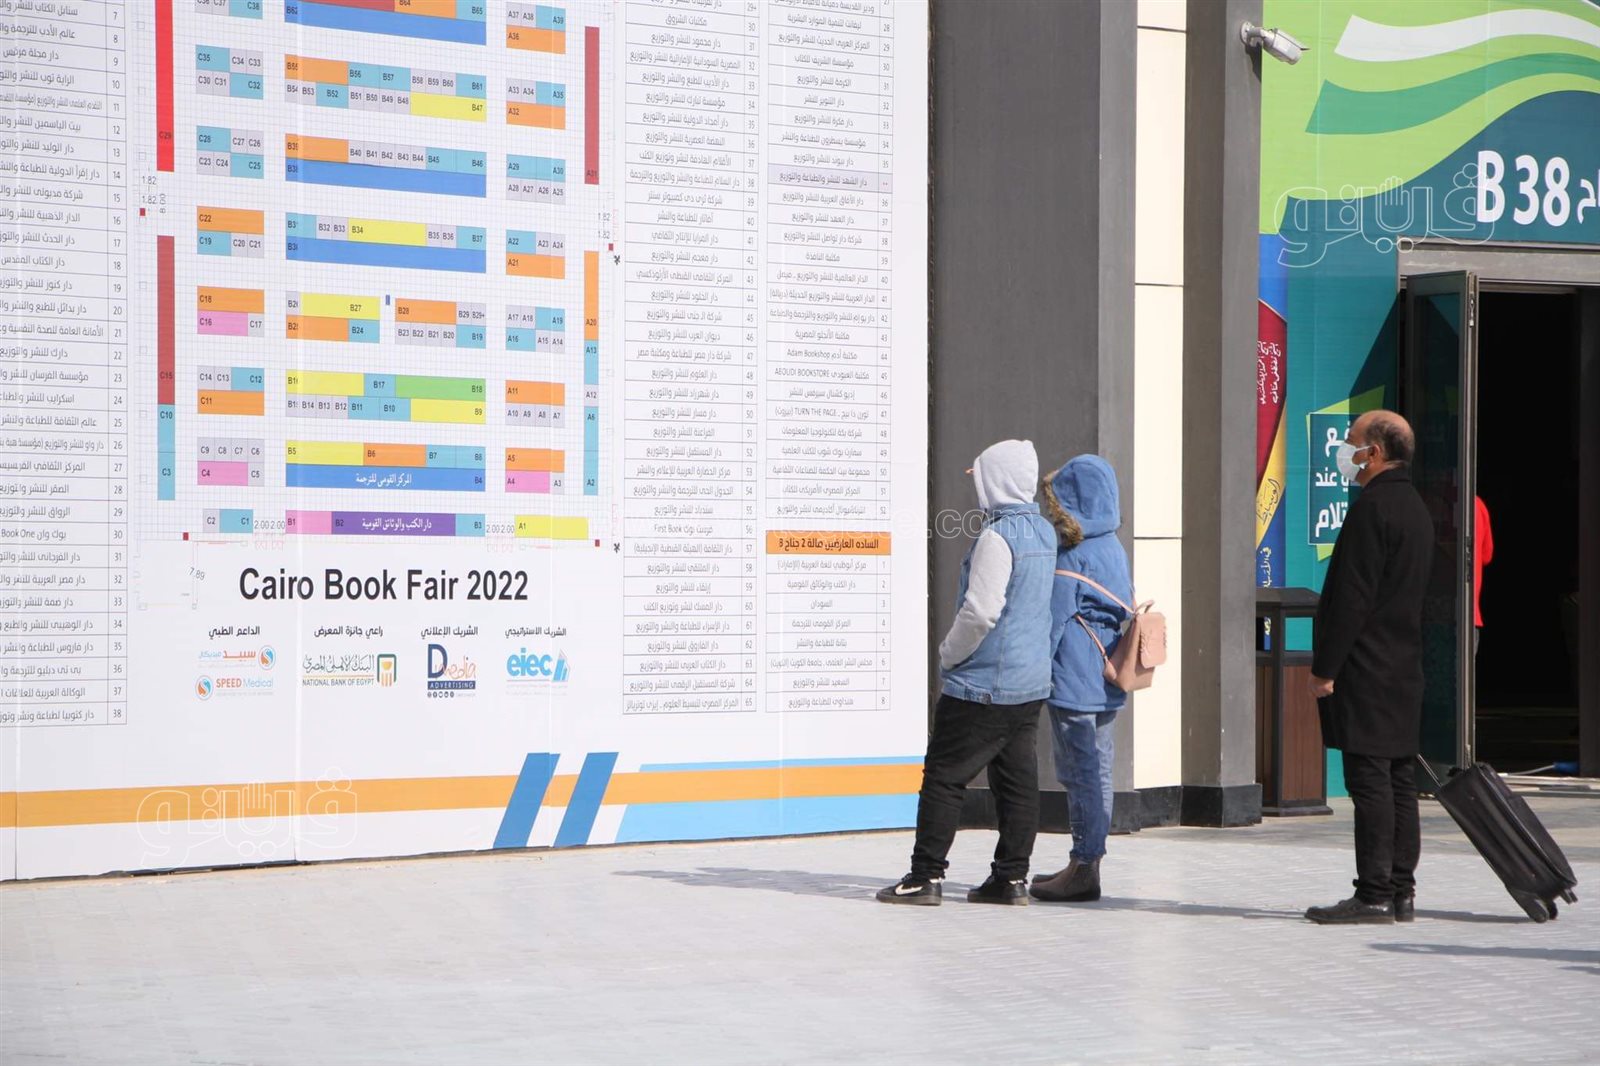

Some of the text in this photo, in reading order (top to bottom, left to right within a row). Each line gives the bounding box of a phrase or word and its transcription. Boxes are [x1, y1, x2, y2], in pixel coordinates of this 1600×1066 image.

[508, 10, 519, 19] A37
[552, 16, 564, 24] A39
[197, 52, 211, 62] C35
[231, 56, 244, 65] C34
[248, 58, 261, 67] C33
[349, 69, 362, 78] B56
[382, 72, 394, 81] B57
[248, 80, 261, 90] C32
[472, 81, 483, 90] B61
[326, 89, 339, 98] B52
[472, 103, 483, 112] B47
[508, 107, 520, 116] A32
[113, 126, 120, 134] 12
[198, 157, 212, 166] C23
[216, 158, 228, 167] C24
[428, 155, 440, 163] B45
[248, 161, 261, 170] C25
[507, 162, 520, 170] A29
[113, 170, 120, 179] 14
[1477, 150, 1505, 222] B
[1513, 154, 1570, 226] 38
[198, 214, 212, 223] C22
[318, 223, 331, 232] B32
[352, 225, 364, 234] B34
[198, 236, 212, 245] C19
[232, 238, 245, 247] C20
[472, 234, 483, 242] B37
[508, 237, 519, 246] A22
[249, 240, 261, 248] C21
[508, 258, 519, 267] A21
[114, 284, 121, 292] 19
[349, 304, 362, 312] B27
[199, 317, 212, 326] C16
[352, 326, 364, 334] B24
[199, 373, 212, 381] C14
[249, 374, 262, 384] C12
[373, 380, 385, 389] B17
[200, 396, 212, 405] C11
[383, 404, 395, 412] B10
[811, 408, 821, 416] THE
[159, 410, 173, 420] C10
[114, 418, 122, 427] 25
[288, 447, 297, 455] B5
[428, 451, 437, 460] B7
[507, 454, 516, 462] A5
[114, 463, 122, 472] 27
[161, 468, 172, 476] C3
[201, 468, 211, 477] C4
[1316, 467, 1337, 486] عند
[586, 478, 595, 486] A2
[206, 516, 216, 525] C2
[240, 517, 249, 525] C1
[287, 518, 296, 526] B1
[423, 519, 432, 532] دار
[2, 528, 19, 538] Book
[20, 528, 35, 538] One
[114, 530, 122, 539] 30
[114, 575, 122, 584] 32
[239, 568, 528, 600] Cairo Book Fair 2022
[208, 626, 260, 640] الداعم الطبي
[314, 626, 343, 638] المعرض
[366, 627, 383, 640] راعي
[453, 625, 478, 638] الشريك
[544, 627, 566, 638] الشريك
[507, 647, 553, 677] eiec
[216, 678, 273, 688] SPEED Medical
